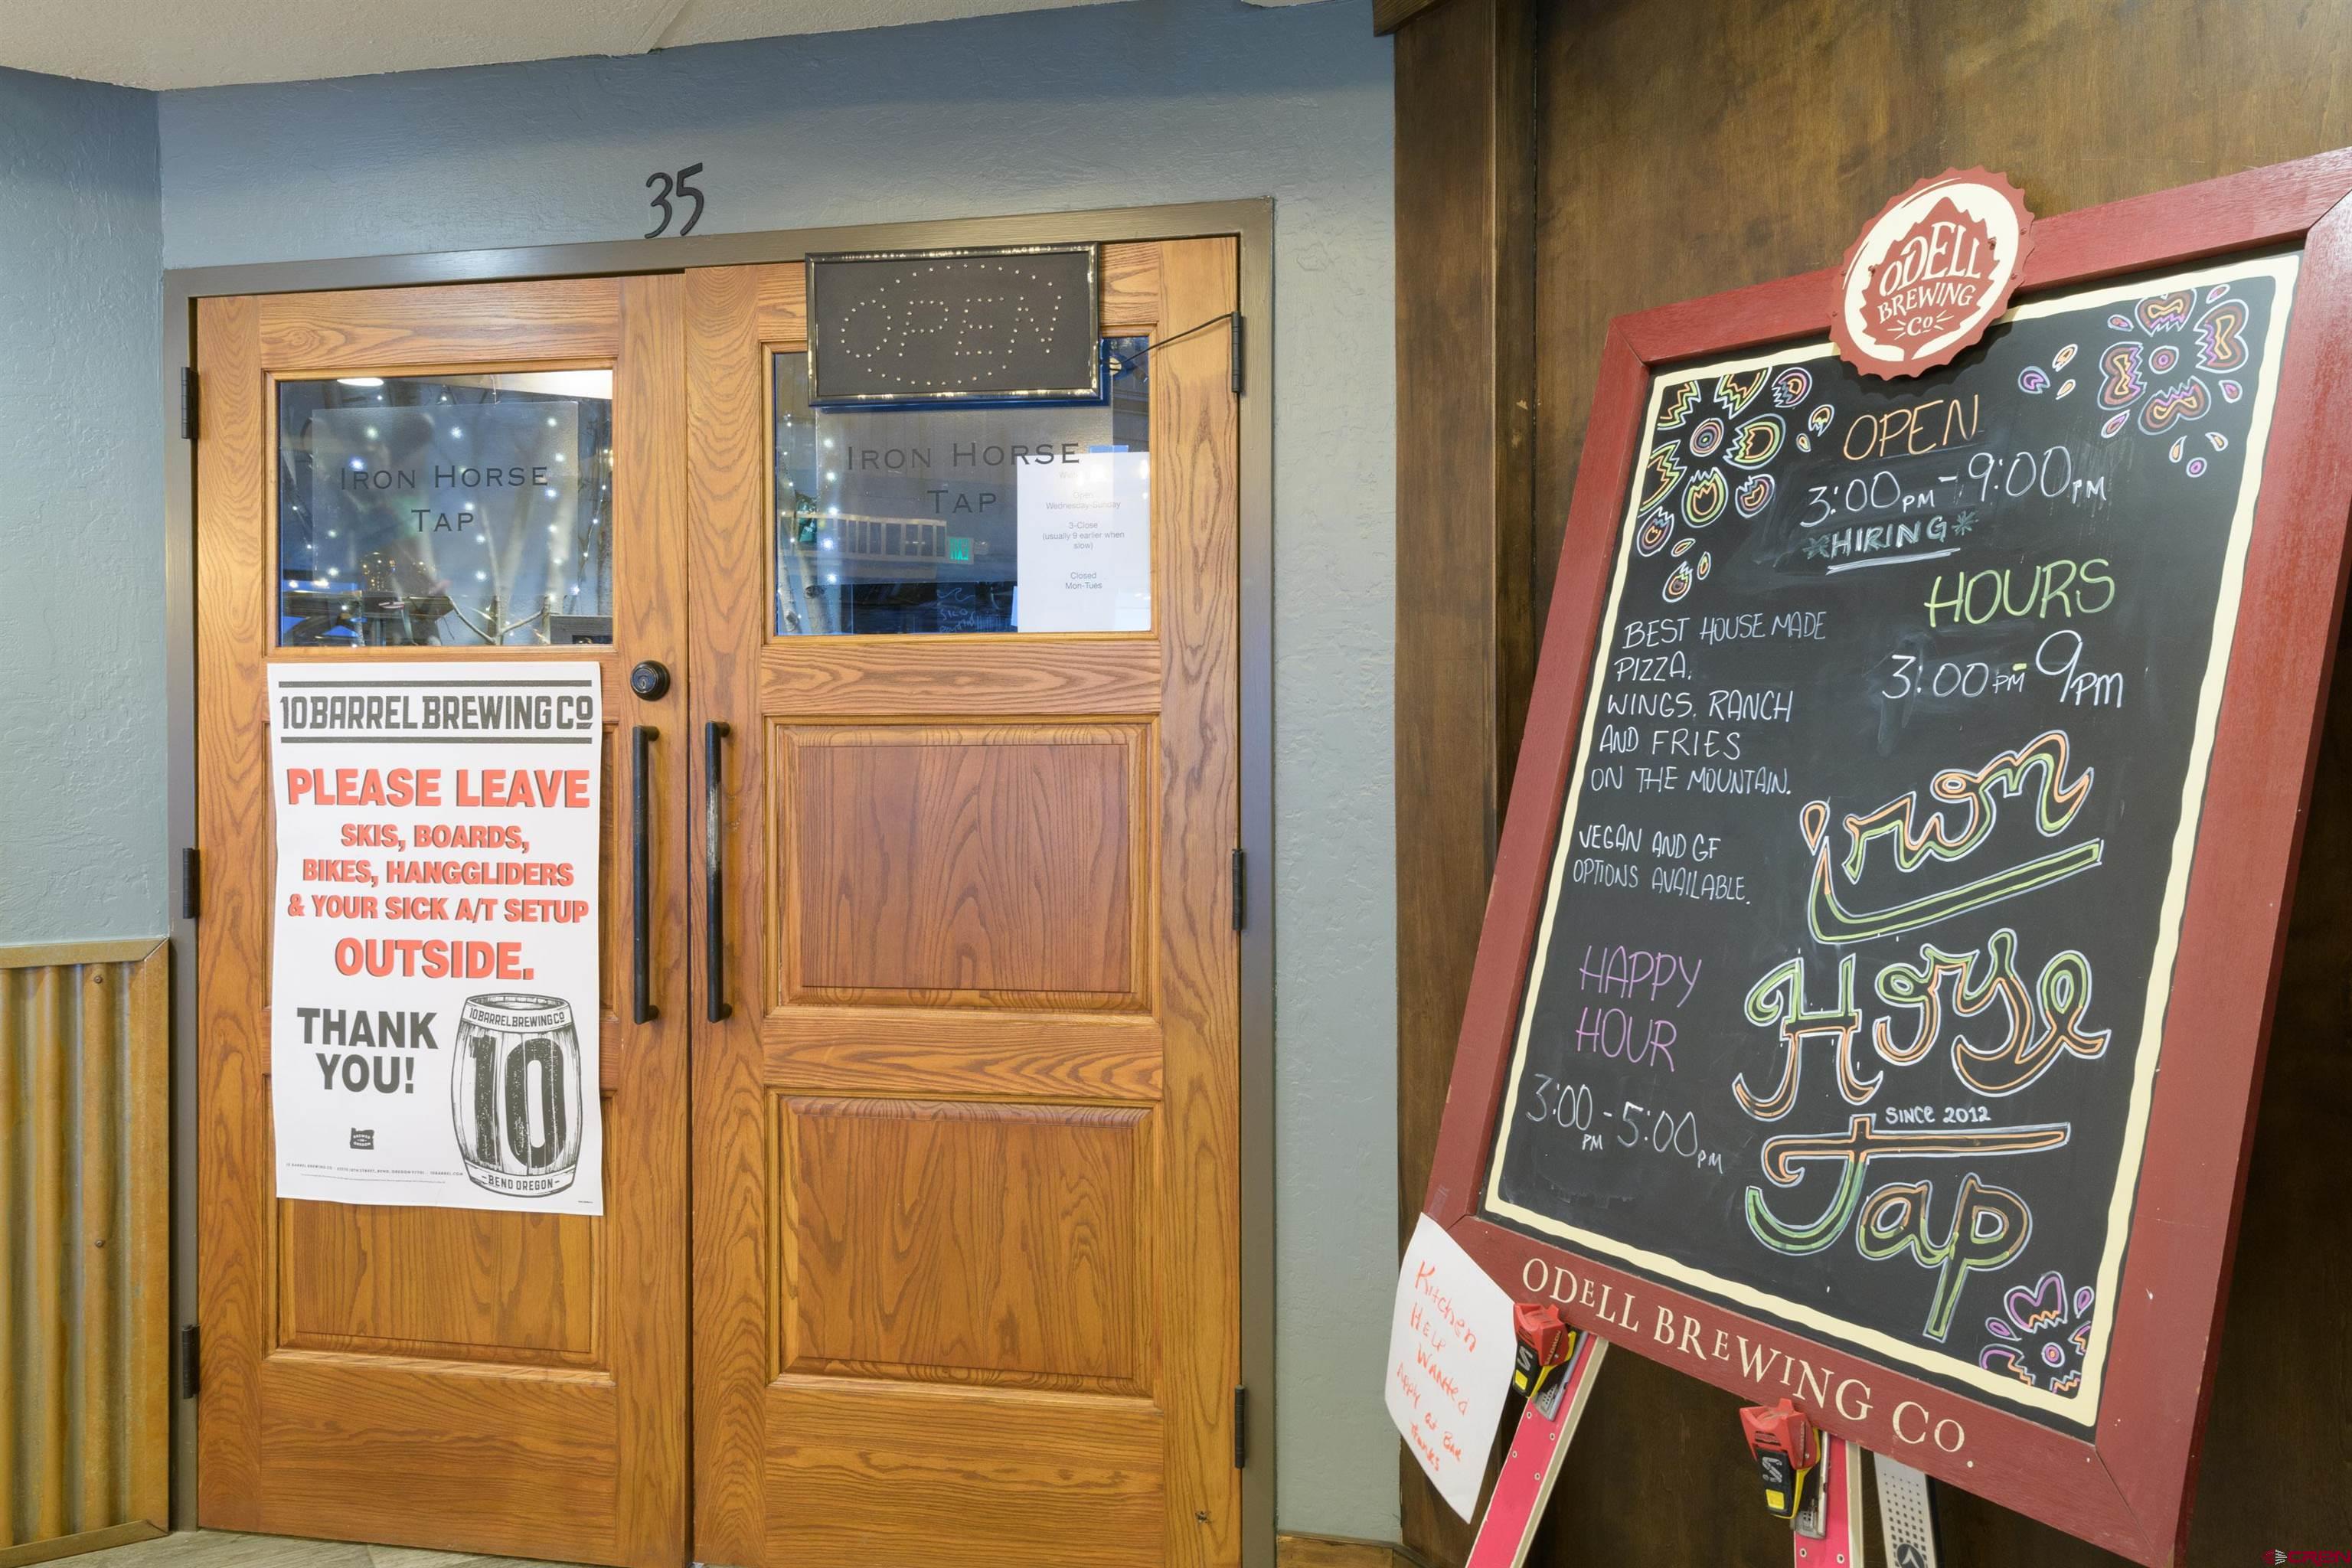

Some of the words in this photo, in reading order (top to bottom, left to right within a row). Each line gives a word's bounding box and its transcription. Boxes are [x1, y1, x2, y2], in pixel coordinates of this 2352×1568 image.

[644, 162, 704, 239] 35
[1880, 221, 1981, 297] ODELL
[1877, 282, 1977, 324] BREWING
[841, 295, 1062, 358] OPEN
[1843, 394, 1980, 460] OPEN
[1073, 541, 1094, 550] slow)
[1065, 581, 1102, 590] Mon-Tues
[1070, 571, 1097, 580] Closed
[1924, 559, 2115, 628] HOURS
[1622, 617, 1691, 649] BEST
[1699, 612, 1766, 645] HOUSE
[1771, 611, 1828, 640] MADE
[422, 695, 552, 730] BREWING
[1708, 689, 1794, 722] RANCH
[1599, 724, 1639, 753] AND
[1651, 728, 1741, 760] FRIES
[286, 767, 442, 807] PLEASE
[456, 769, 590, 808] LEAVE
[1590, 766, 1623, 792] ON
[1635, 766, 1679, 793] THE
[1687, 766, 1792, 795] MOUNTAIN.
[341, 823, 406, 851] SKIS,
[413, 824, 530, 854] BOARDS,
[1579, 823, 1642, 852] VEGAN
[1651, 831, 1686, 859] AND
[1692, 833, 1722, 862] GF
[302, 858, 379, 887] BIKES,
[386, 861, 574, 887] HANGGLIDERS
[1573, 858, 1638, 888] OPTIONS
[1651, 867, 1751, 905] AVAILABLE.
[287, 893, 305, 916] &
[312, 894, 378, 919] YOUR
[385, 896, 449, 920] SICK
[455, 897, 498, 923] A/T
[504, 899, 590, 923] SETUP
[335, 936, 534, 981] OUTSIDE.
[1579, 945, 1702, 1008] HAPPY
[296, 1007, 439, 1050] THANK
[1575, 1007, 1677, 1073] HOUR
[315, 1053, 415, 1094] YOU!
[469, 1034, 567, 1168] 10
[1942, 1106, 1992, 1124] 2012
[488, 1174, 513, 1190] BEND
[516, 1178, 554, 1191] OREGON
[1521, 1257, 1640, 1333] ODELL
[1653, 1305, 1873, 1422] BREWING
